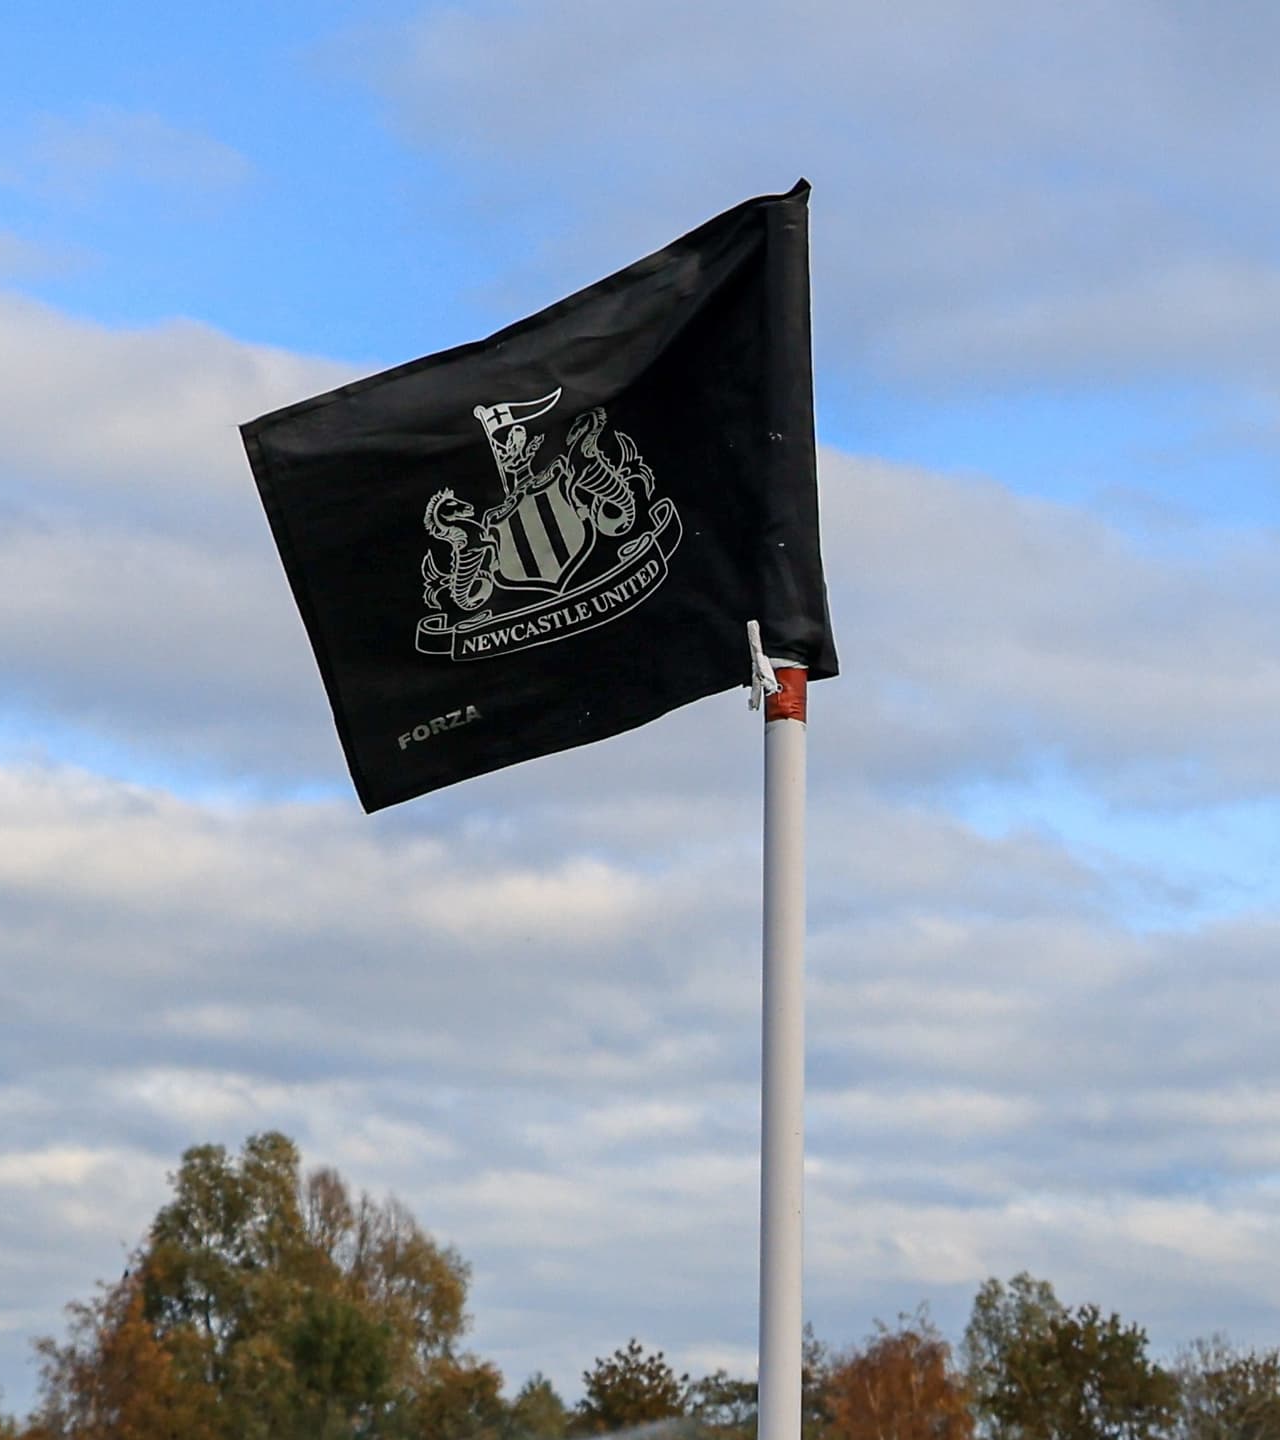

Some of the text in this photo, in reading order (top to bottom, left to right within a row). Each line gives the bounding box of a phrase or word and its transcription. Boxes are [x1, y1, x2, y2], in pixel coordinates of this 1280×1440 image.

[461, 559, 660, 654] NEWCASTLE UNITED
[397, 704, 481, 750] FORZA
